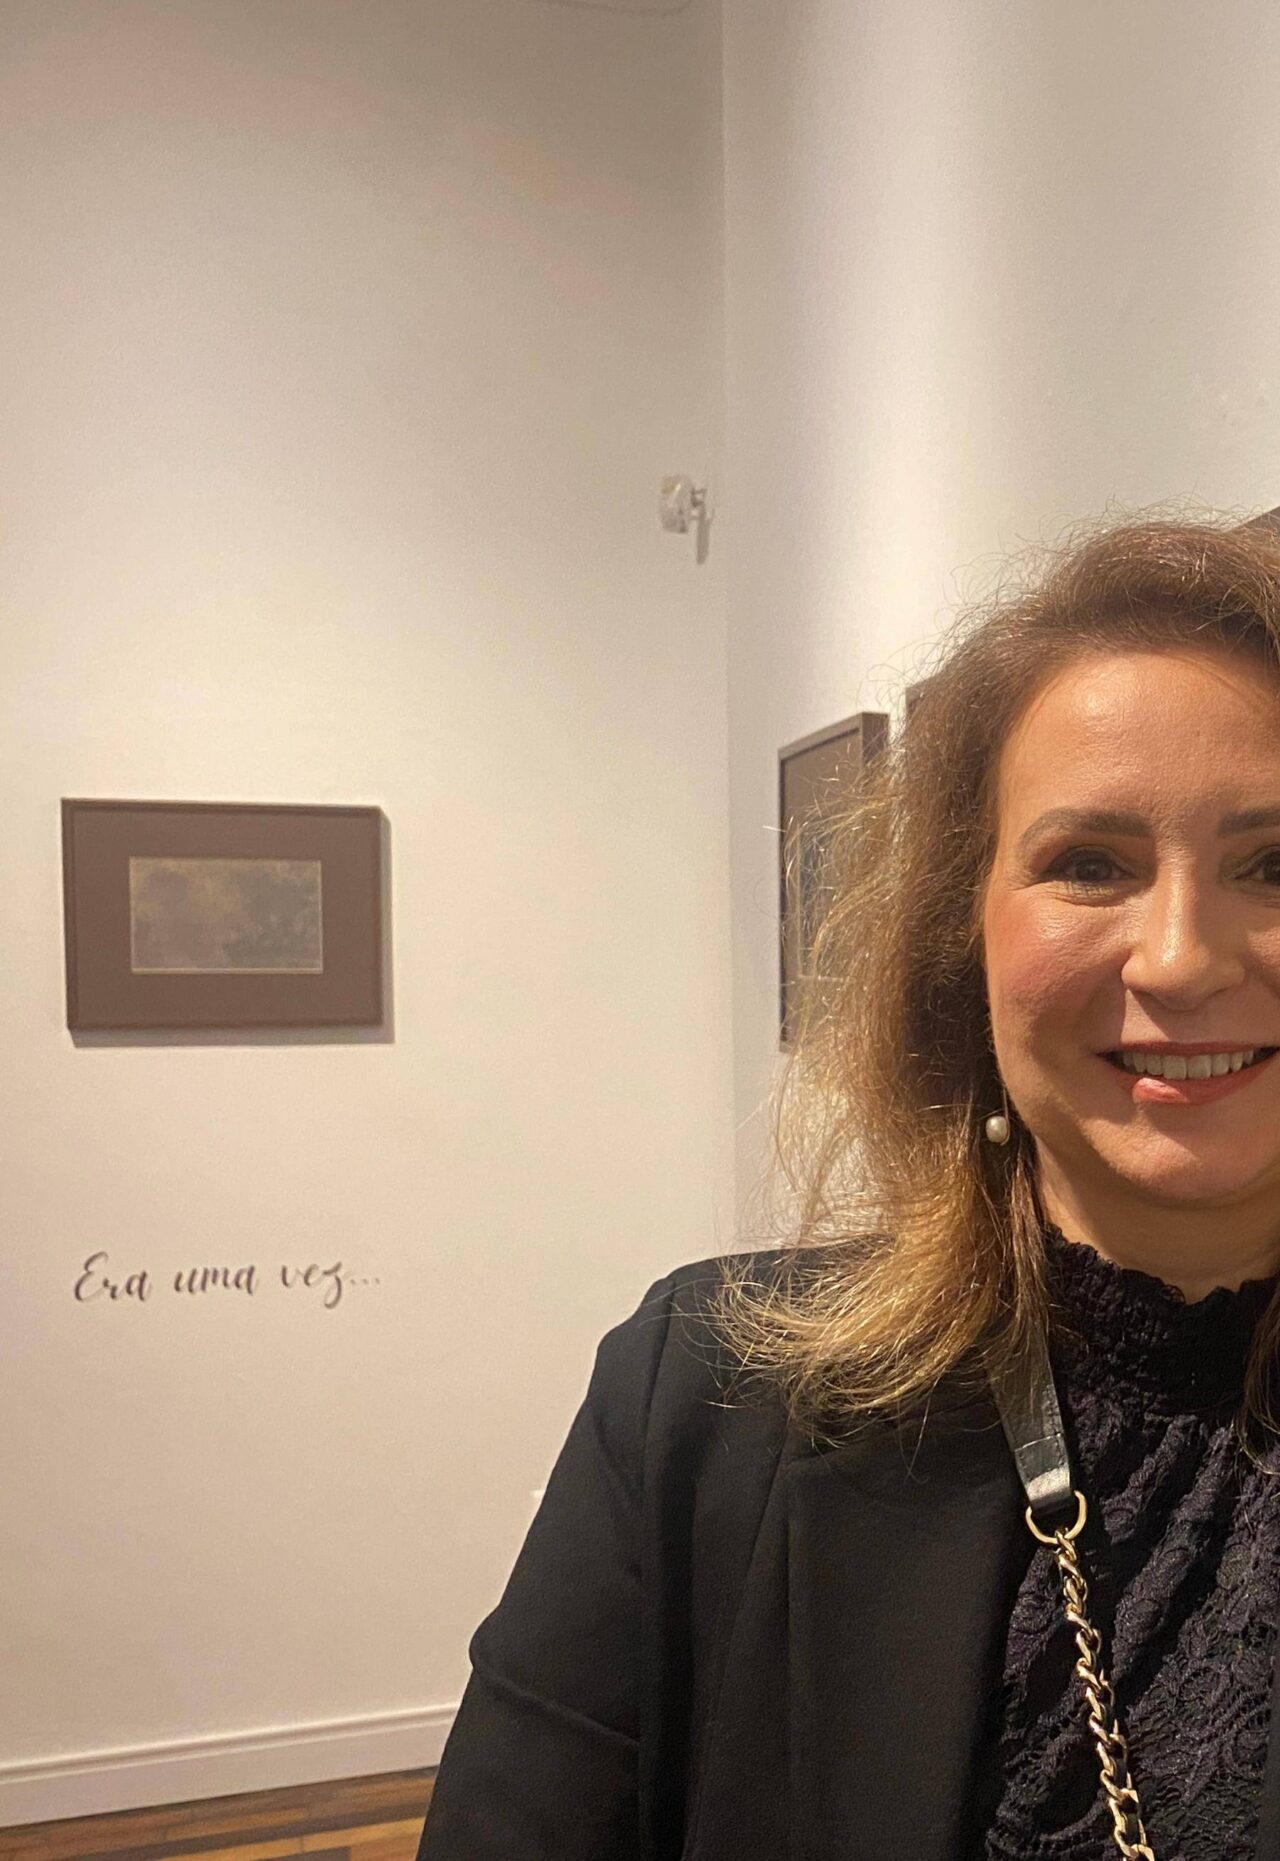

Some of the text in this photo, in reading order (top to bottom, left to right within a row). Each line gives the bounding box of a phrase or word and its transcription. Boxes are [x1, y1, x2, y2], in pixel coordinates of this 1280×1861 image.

[73, 1251, 381, 1310] Era uma vez...
